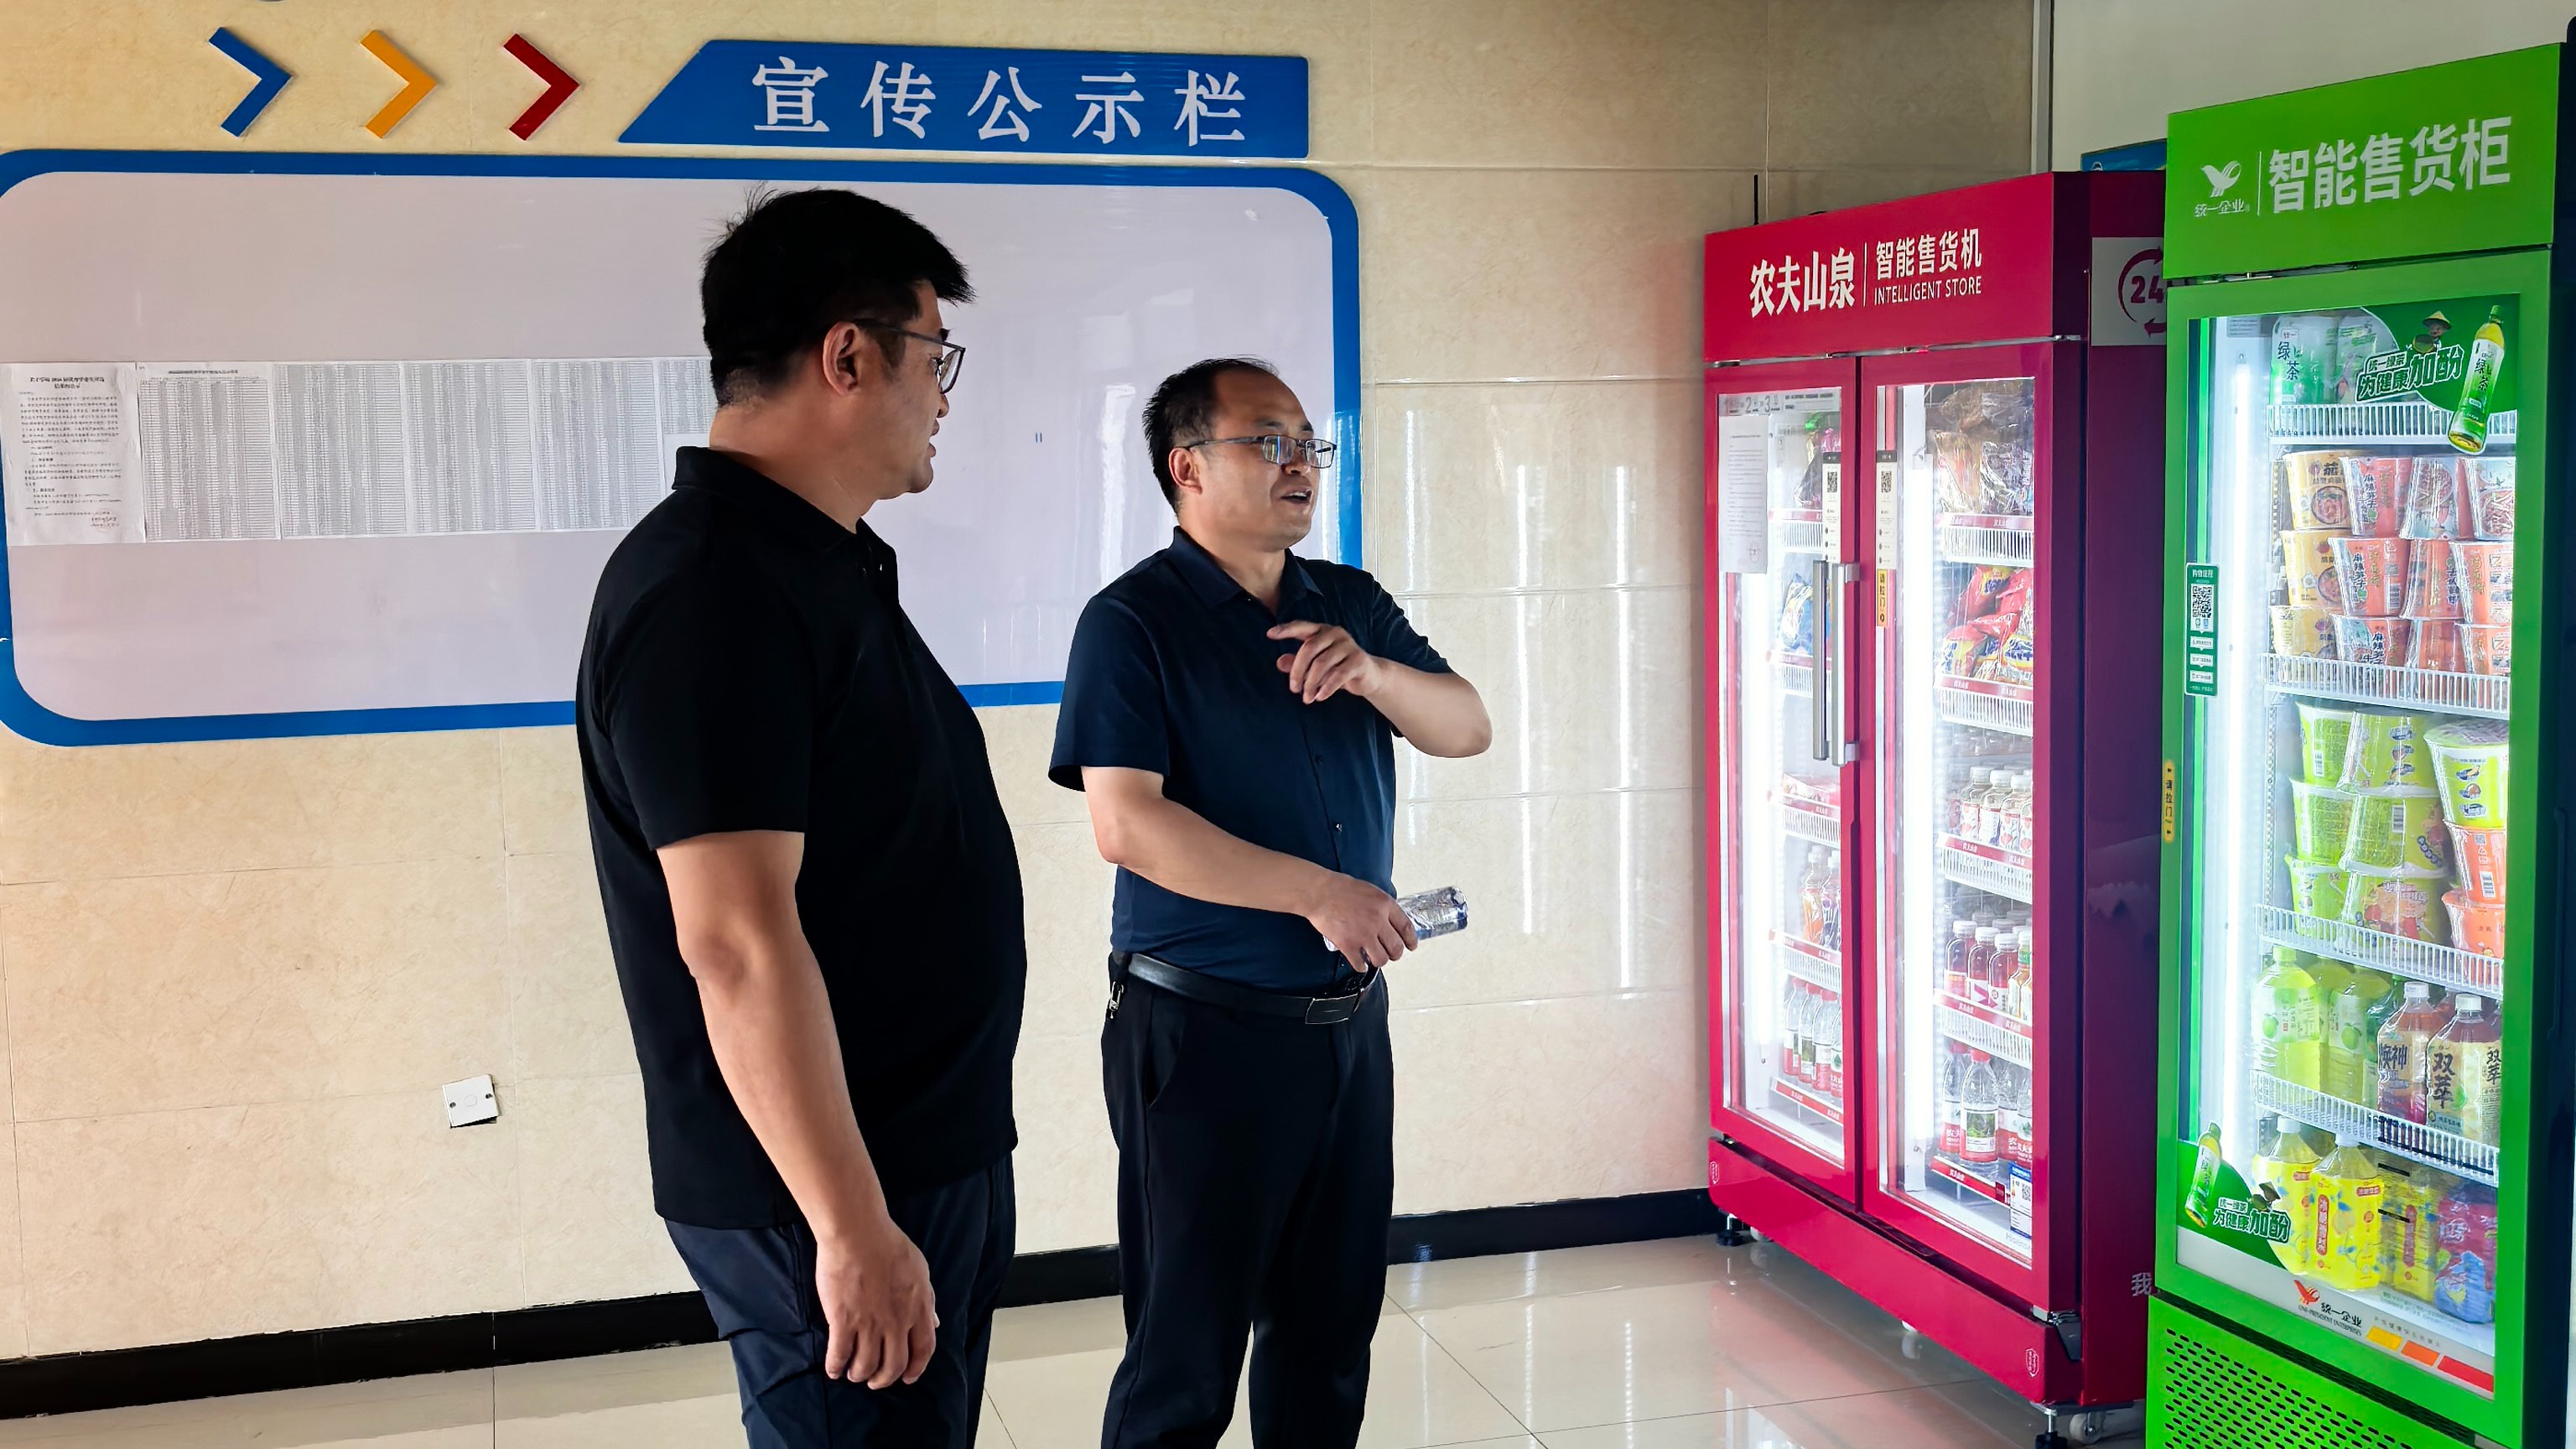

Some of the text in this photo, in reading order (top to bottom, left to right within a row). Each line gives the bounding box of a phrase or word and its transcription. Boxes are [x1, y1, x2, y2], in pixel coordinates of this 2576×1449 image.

[751, 56, 1246, 146] 宣传公示栏
[2269, 116, 2513, 214] 智能售货柜
[2194, 198, 2246, 217] 统一企业
[1875, 228, 1982, 282] 智能售货机
[1749, 247, 1856, 319] 农夫山泉
[1874, 276, 1982, 305] INTELLIGENT STORE
[2130, 275, 2165, 304] 24
[2358, 345, 2464, 400] 为健康加酚
[2320, 1302, 2362, 1327] 统一企业
